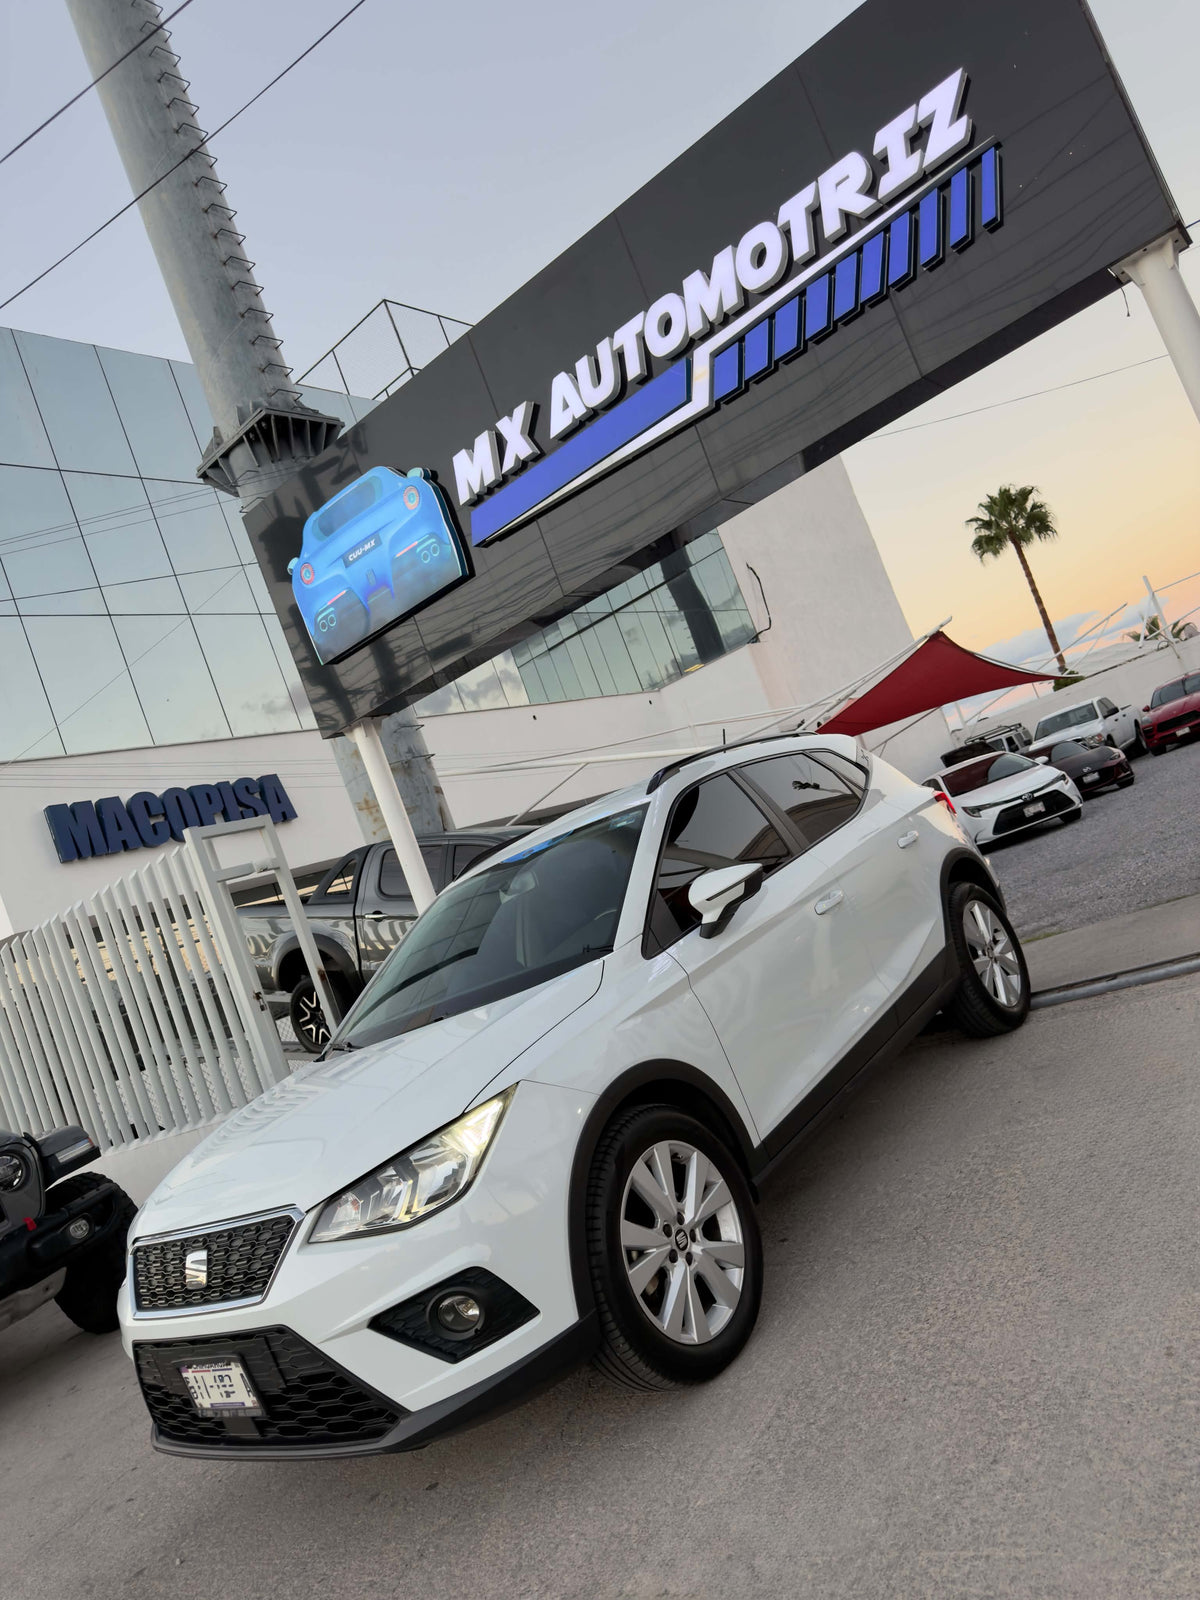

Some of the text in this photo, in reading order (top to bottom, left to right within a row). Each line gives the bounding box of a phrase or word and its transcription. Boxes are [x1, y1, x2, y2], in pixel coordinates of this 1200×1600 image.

[453, 67, 973, 506] MX AUTOMOTRIZ
[348, 538, 376, 561] CUU-MX
[43, 773, 299, 863] MACOPISA
